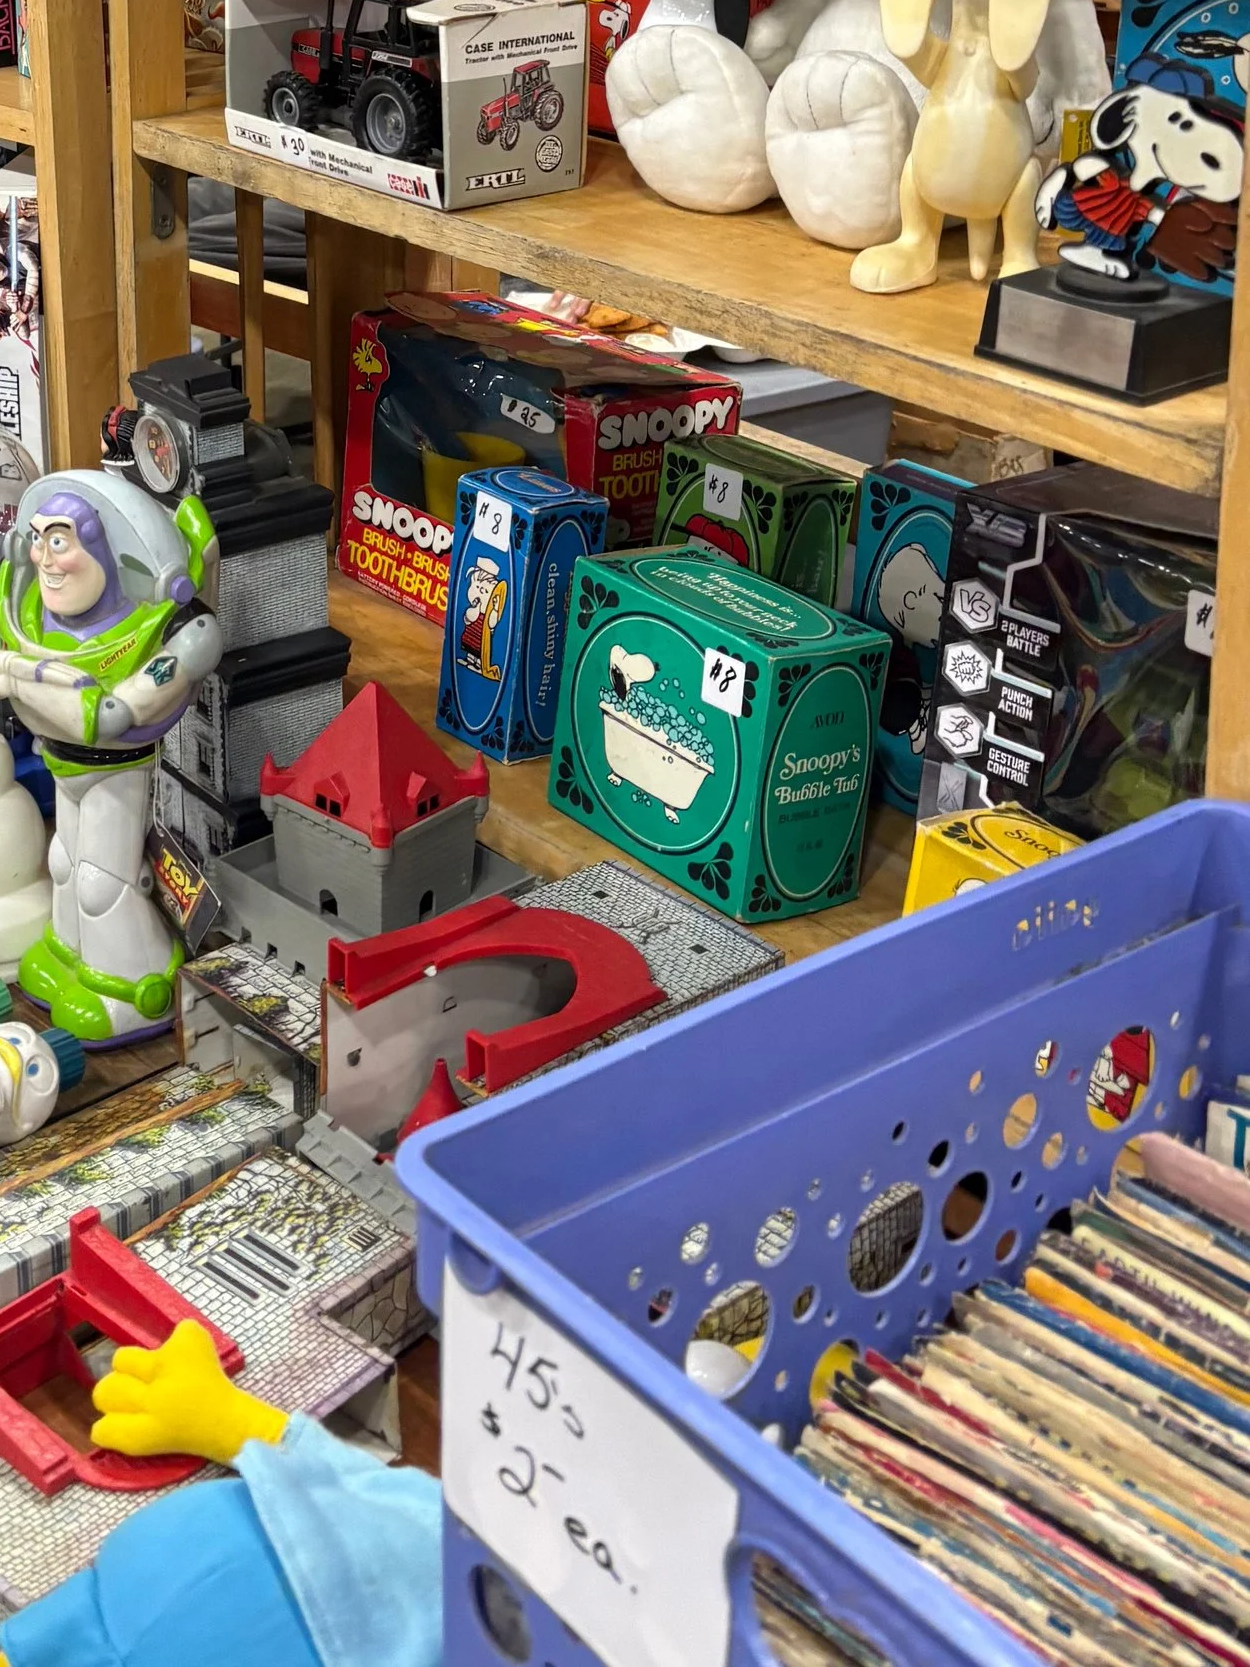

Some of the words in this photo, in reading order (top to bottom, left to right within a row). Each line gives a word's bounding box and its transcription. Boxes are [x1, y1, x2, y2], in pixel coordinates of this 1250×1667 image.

[464, 54, 489, 65] Tractor
[489, 53, 505, 63] with
[505, 49, 543, 62] Mechanical
[543, 46, 562, 58] Front
[561, 43, 579, 55] Drive
[465, 39, 495, 55] CASE
[498, 30, 576, 52] INTERNATIONAL
[309, 147, 328, 161] with
[327, 150, 373, 175] Mechanical
[326, 162, 350, 178] Drive
[466, 167, 527, 192] ERTL
[597, 396, 735, 451] SNOOPY
[613, 448, 663, 472] BRUSH
[362, 527, 406, 560] BRUSH
[706, 570, 777, 608] Happiness
[959, 588, 992, 624] VS
[542, 614, 559, 665] shiny
[1006, 634, 1041, 658] BATTLE
[1008, 622, 1050, 648] PLAYERS
[99, 637, 139, 672] LIGHTYEAR
[997, 698, 1033, 723] ACTION
[1001, 685, 1034, 709] PUNCH
[779, 743, 862, 781] Snoopy's
[986, 759, 1029, 787] CONTROL
[988, 747, 1031, 775] GESTURE
[774, 783, 832, 806] Bubble
[833, 773, 861, 793] Tub
[563, 1516, 639, 1596] ea.
